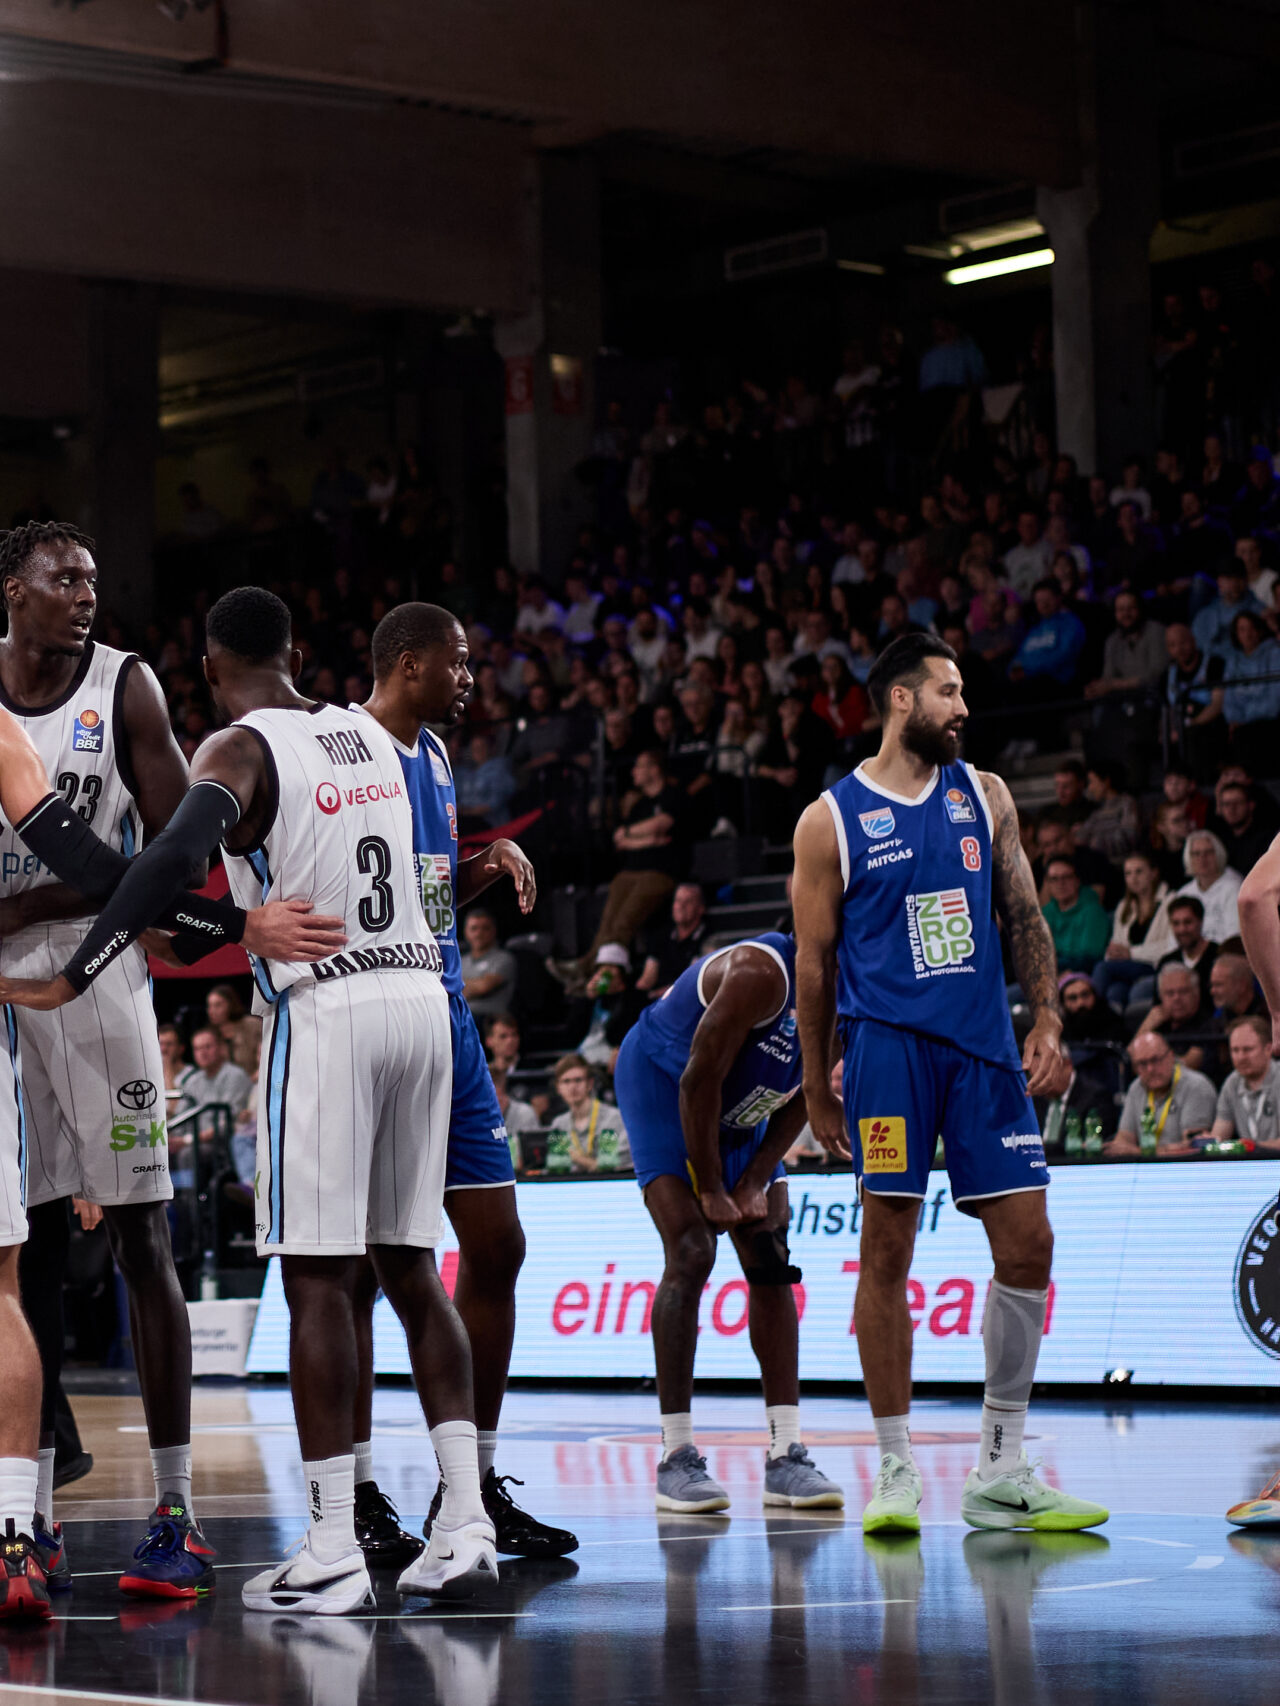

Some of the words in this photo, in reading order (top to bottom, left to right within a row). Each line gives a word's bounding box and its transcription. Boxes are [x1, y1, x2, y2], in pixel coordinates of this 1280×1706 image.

[75, 738, 100, 750] BBL
[315, 729, 374, 765] RICH
[57, 771, 103, 825] 23
[343, 781, 403, 806] VEOLIA
[867, 848, 914, 870] MITGAS
[868, 839, 895, 854] CRAFT
[960, 836, 981, 872] 8
[356, 835, 395, 933] 3
[176, 913, 215, 932] CRAFT
[905, 894, 925, 972] SYNTAINICS
[84, 938, 118, 975] CRAFT
[109, 1120, 167, 1152] S+K
[132, 1164, 162, 1174] CRAFT
[866, 1147, 898, 1161] OTTO
[1245, 1218, 1278, 1266] VEO
[552, 1263, 658, 1335] ein
[994, 1424, 1003, 1451] CRAFT
[310, 1480, 322, 1511] CRAFT
